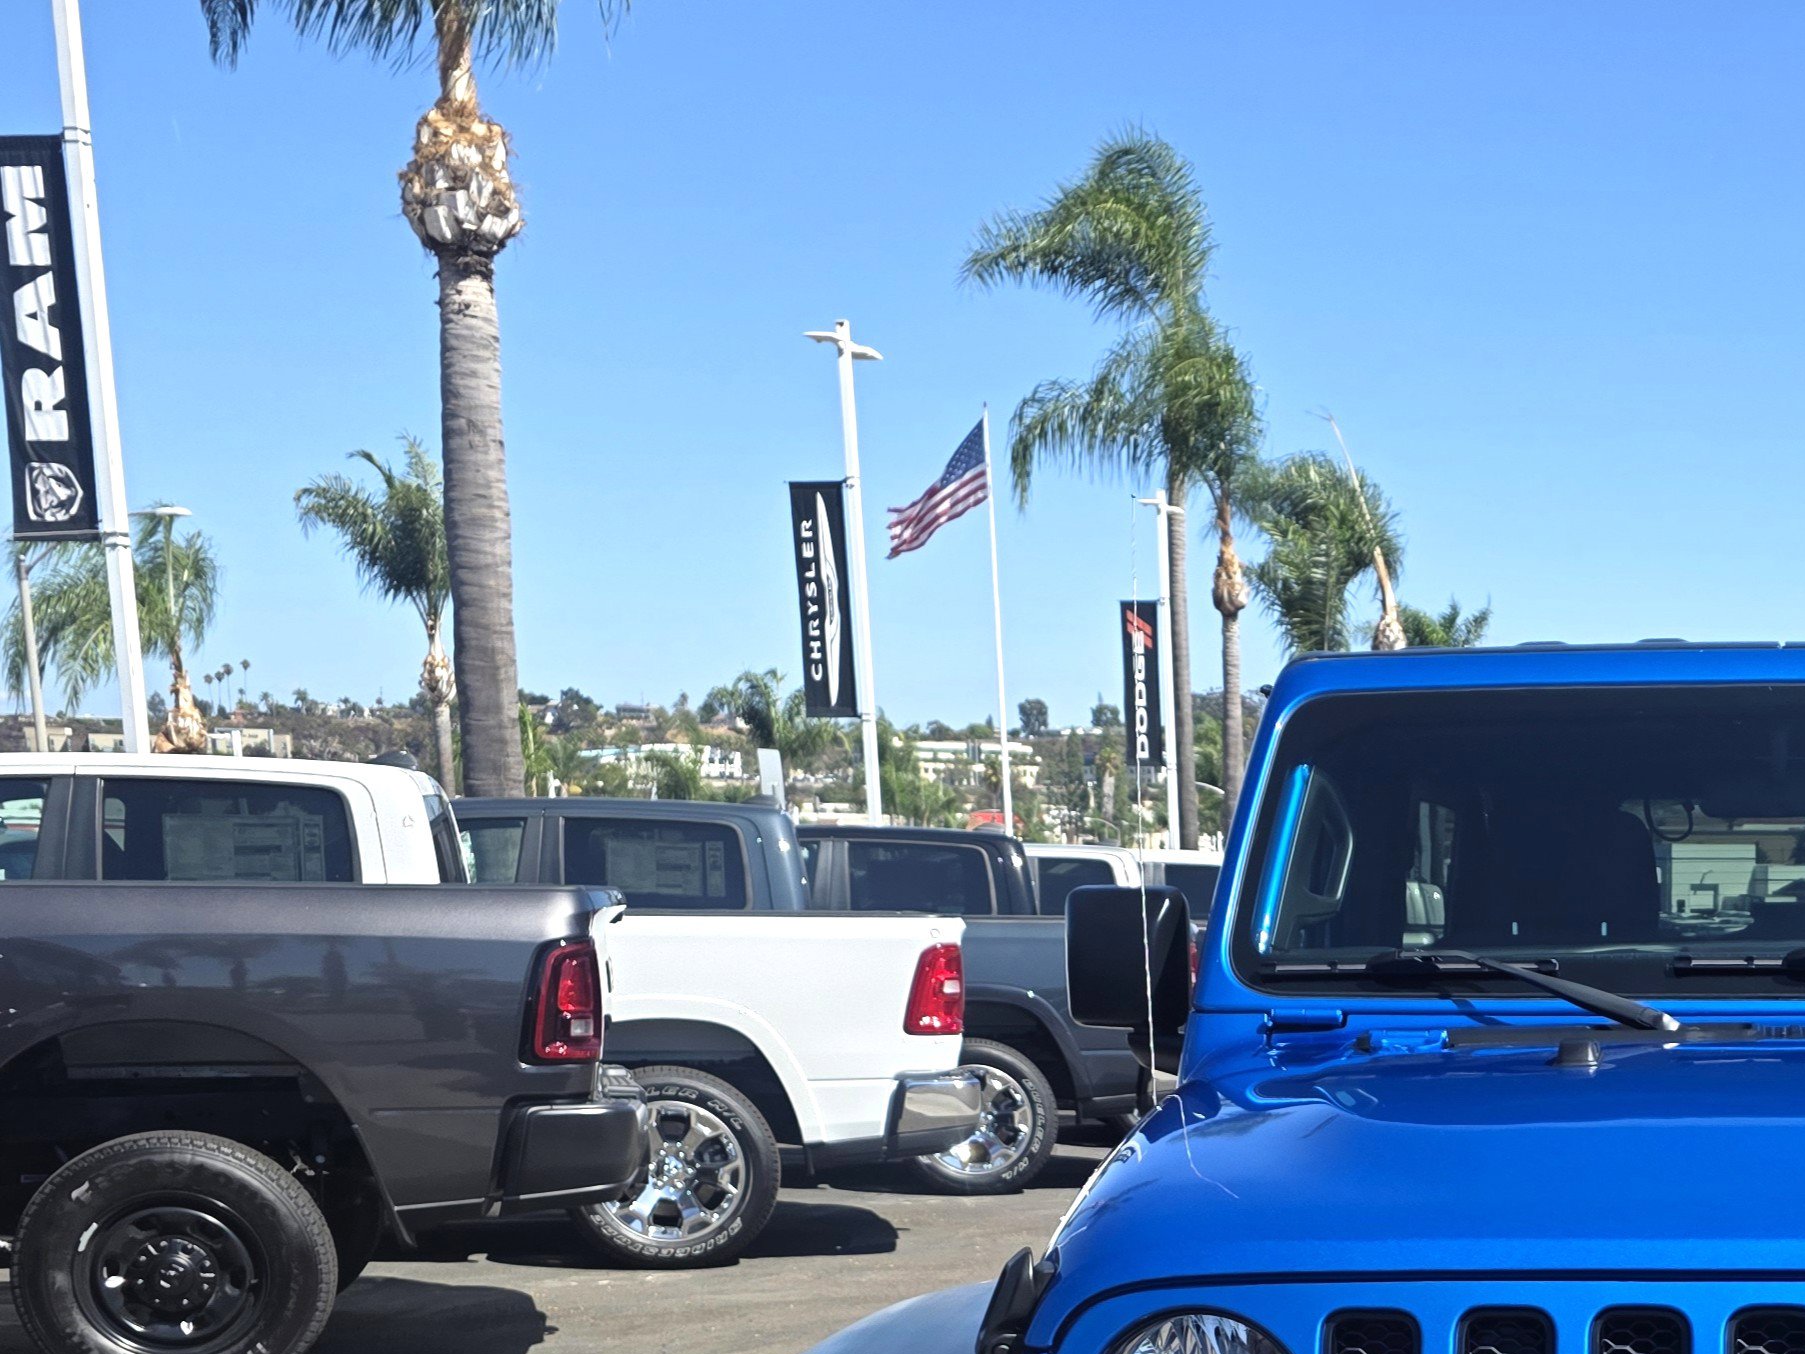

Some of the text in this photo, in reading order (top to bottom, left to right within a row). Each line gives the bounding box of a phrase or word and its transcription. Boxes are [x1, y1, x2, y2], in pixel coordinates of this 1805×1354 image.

[0, 165, 69, 442] RAM
[800, 518, 823, 681] CHRYSLER
[1132, 630, 1149, 758] DODGE
